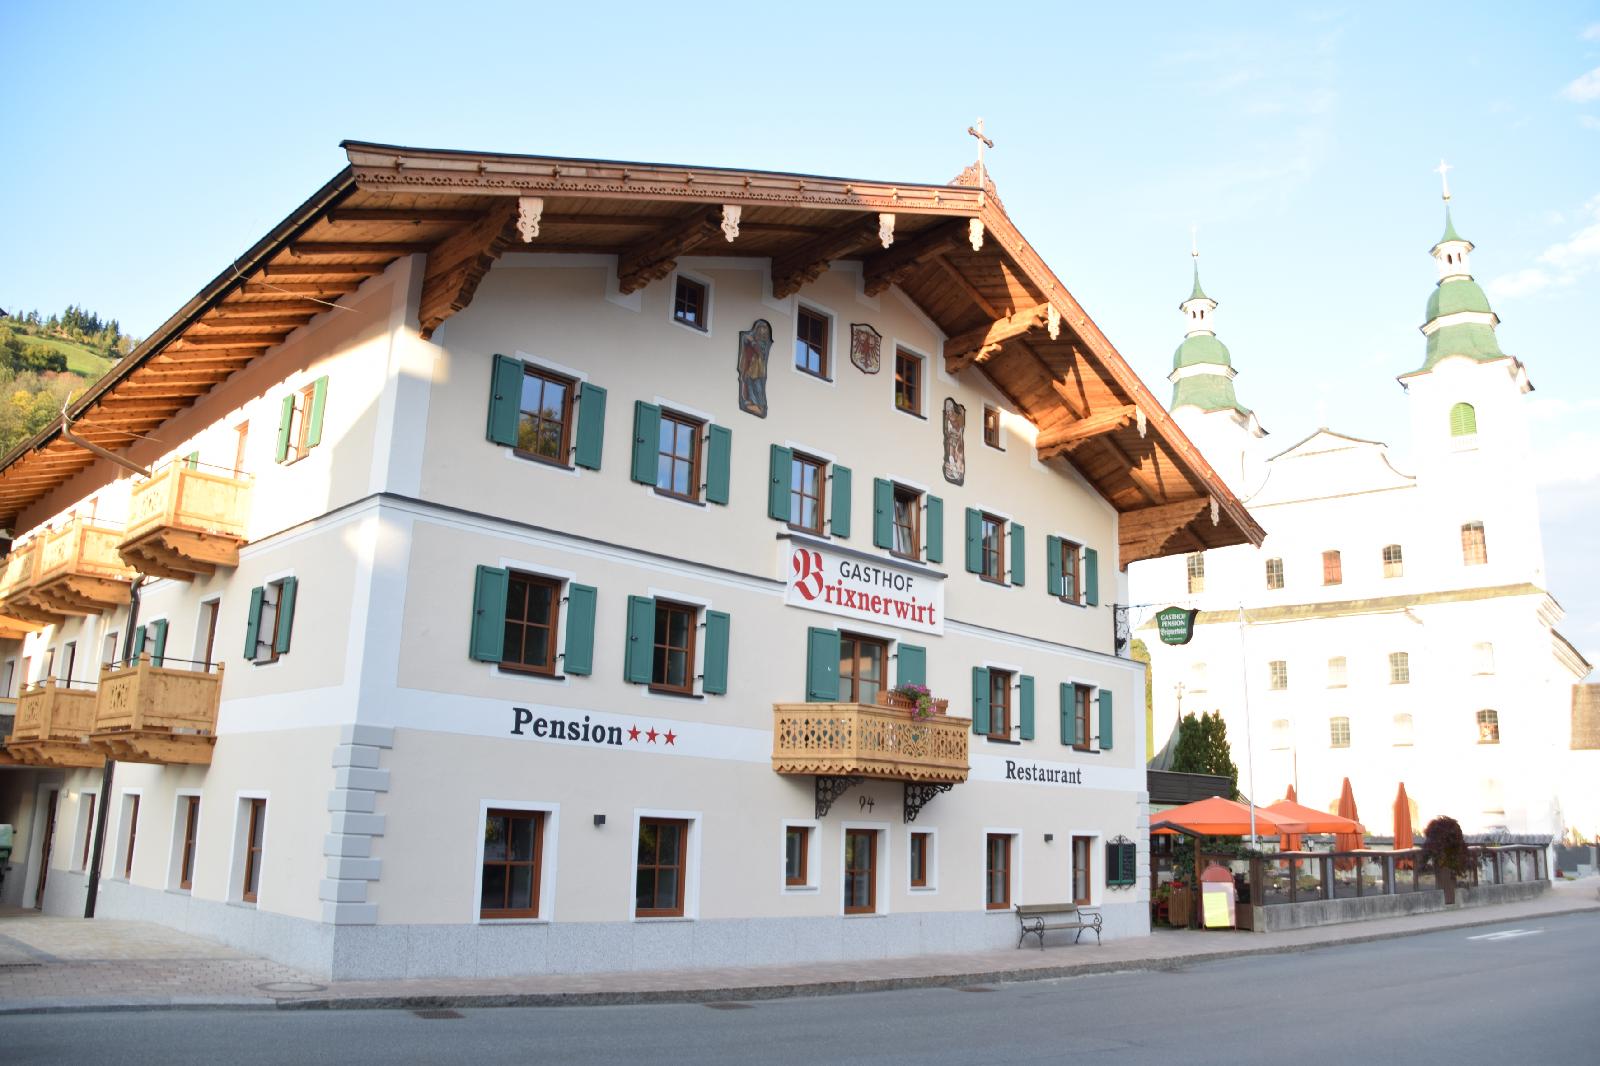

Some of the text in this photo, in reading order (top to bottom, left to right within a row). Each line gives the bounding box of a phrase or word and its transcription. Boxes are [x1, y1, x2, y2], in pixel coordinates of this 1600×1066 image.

[792, 548, 936, 625] Brixnerwirt
[840, 561, 914, 592] GASTHOF
[1161, 620, 1185, 628] PENSION
[510, 707, 623, 745] Pension
[1005, 760, 1082, 784] Restaurant
[859, 795, 875, 814] 94
